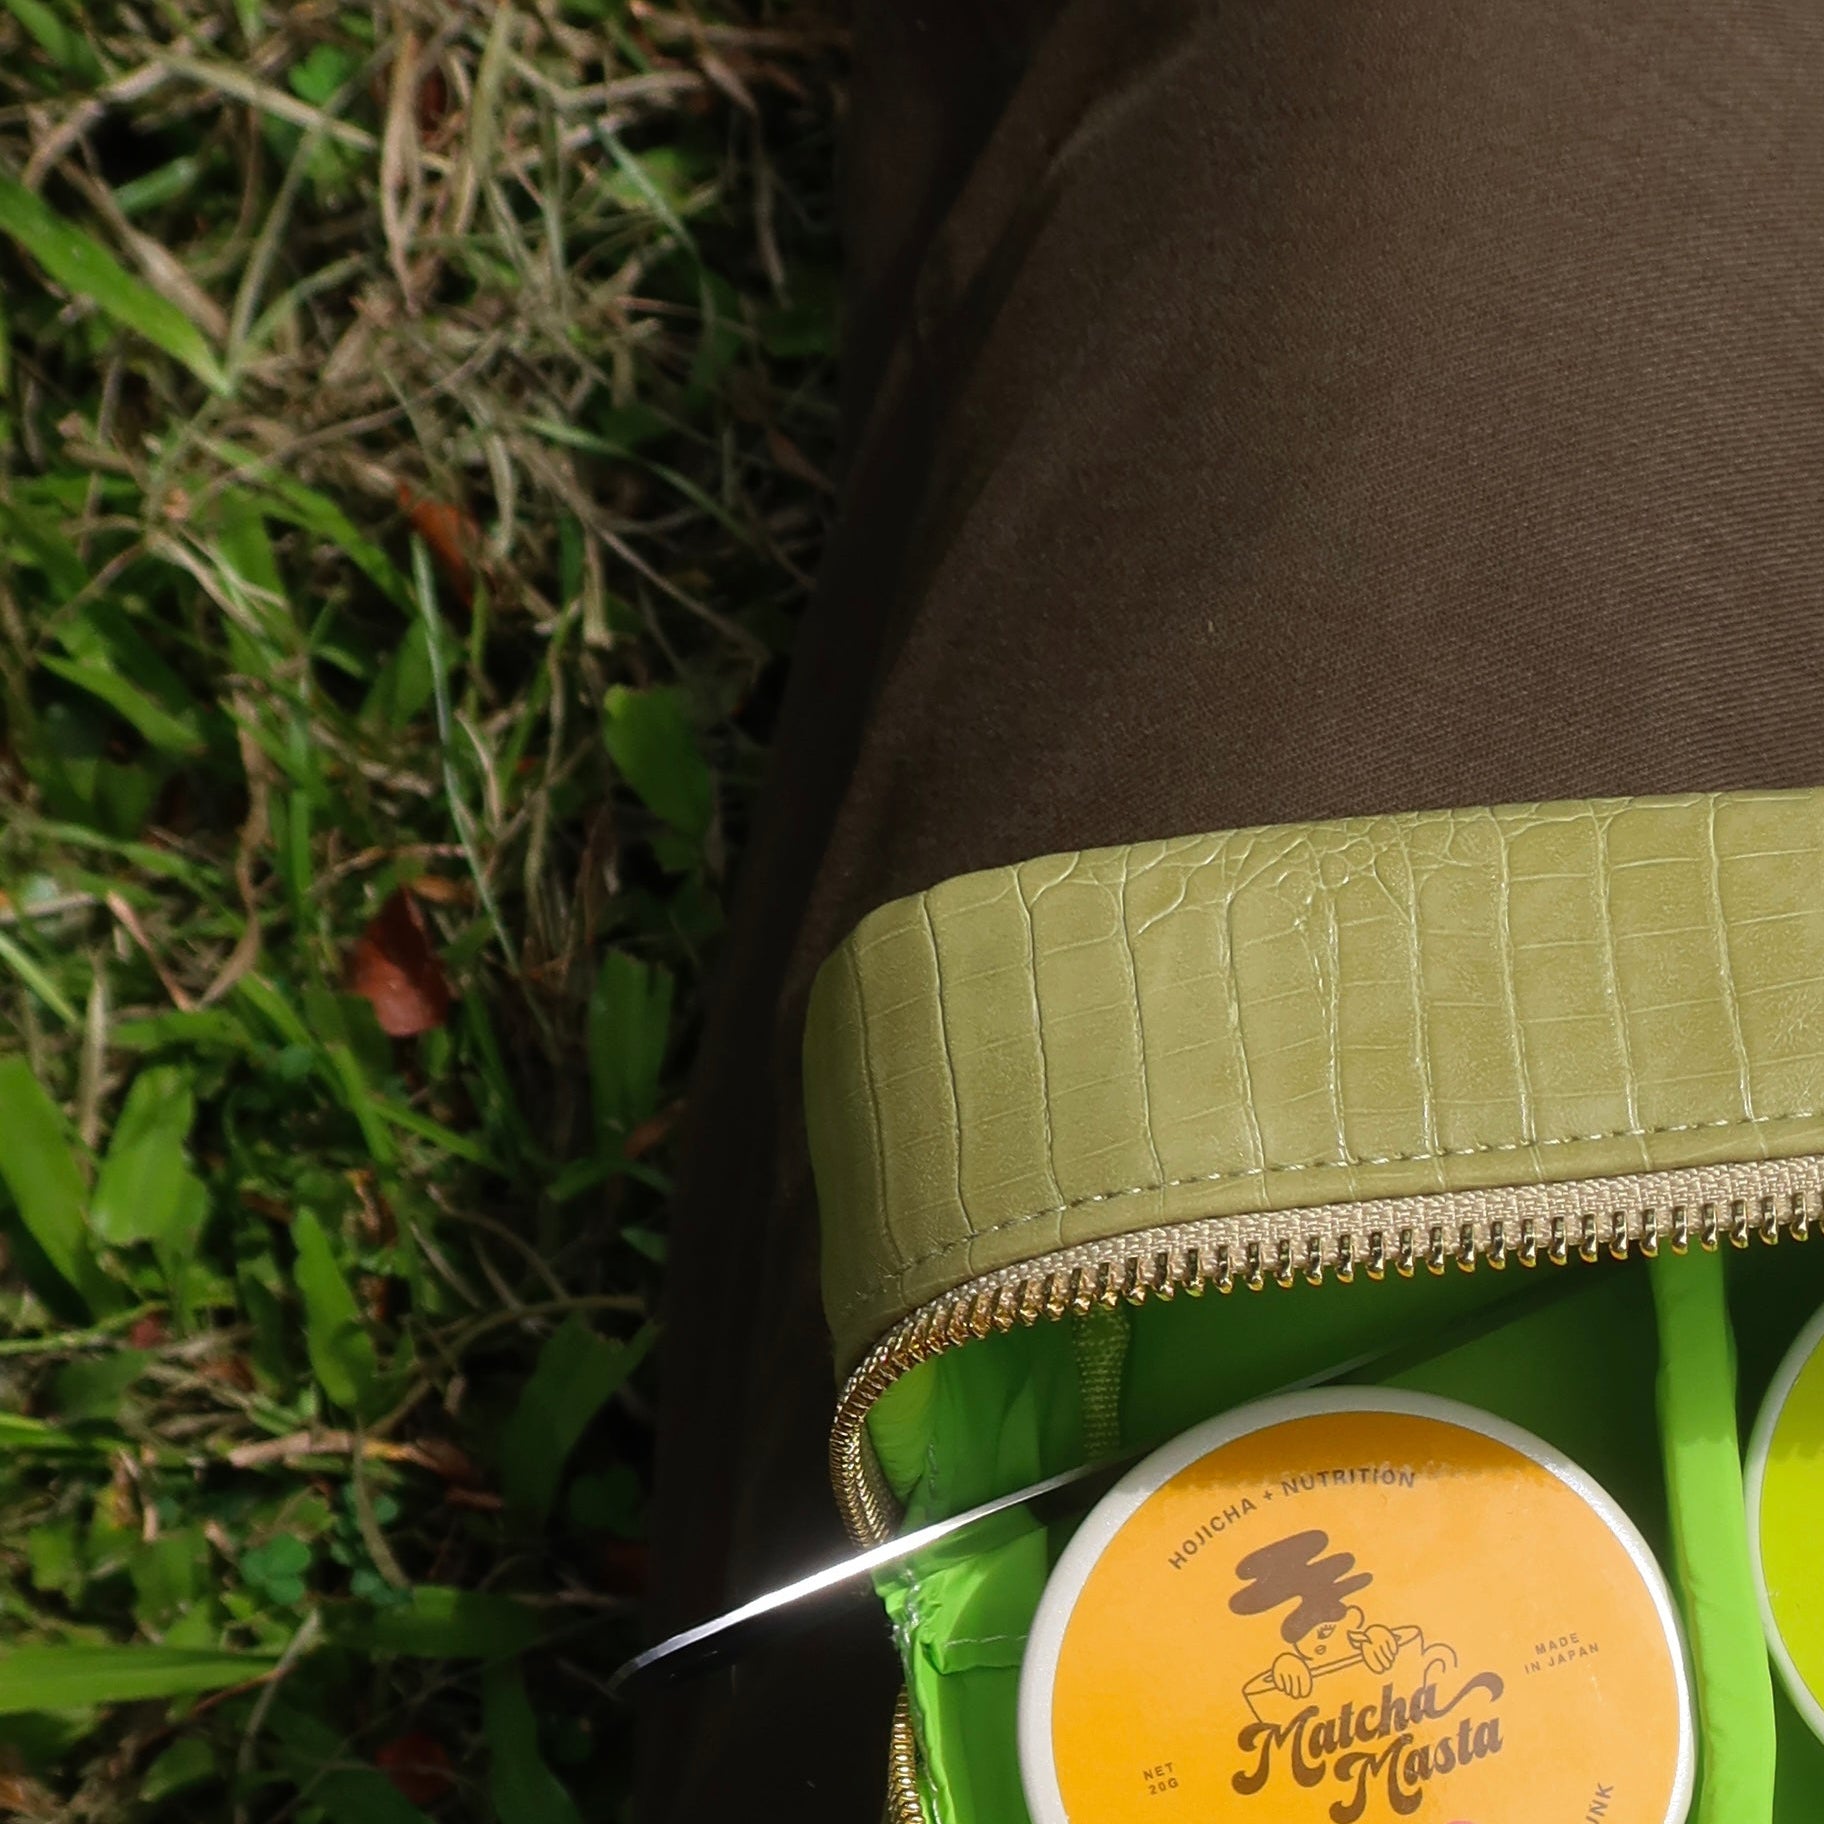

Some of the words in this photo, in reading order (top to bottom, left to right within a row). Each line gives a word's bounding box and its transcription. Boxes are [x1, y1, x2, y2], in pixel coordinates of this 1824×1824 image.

[1168, 1497, 1258, 1570] HOJICHA
[1281, 1468, 1416, 1494] NUTRITION
[1524, 1661, 1541, 1675] IN
[1548, 1642, 1599, 1667] JAPAN
[1534, 1632, 1580, 1655] MADE
[1231, 1671, 1505, 1795] Matcha
[1142, 1762, 1174, 1781] NET
[1148, 1777, 1179, 1796] 20G
[1328, 1716, 1503, 1824] Masta
